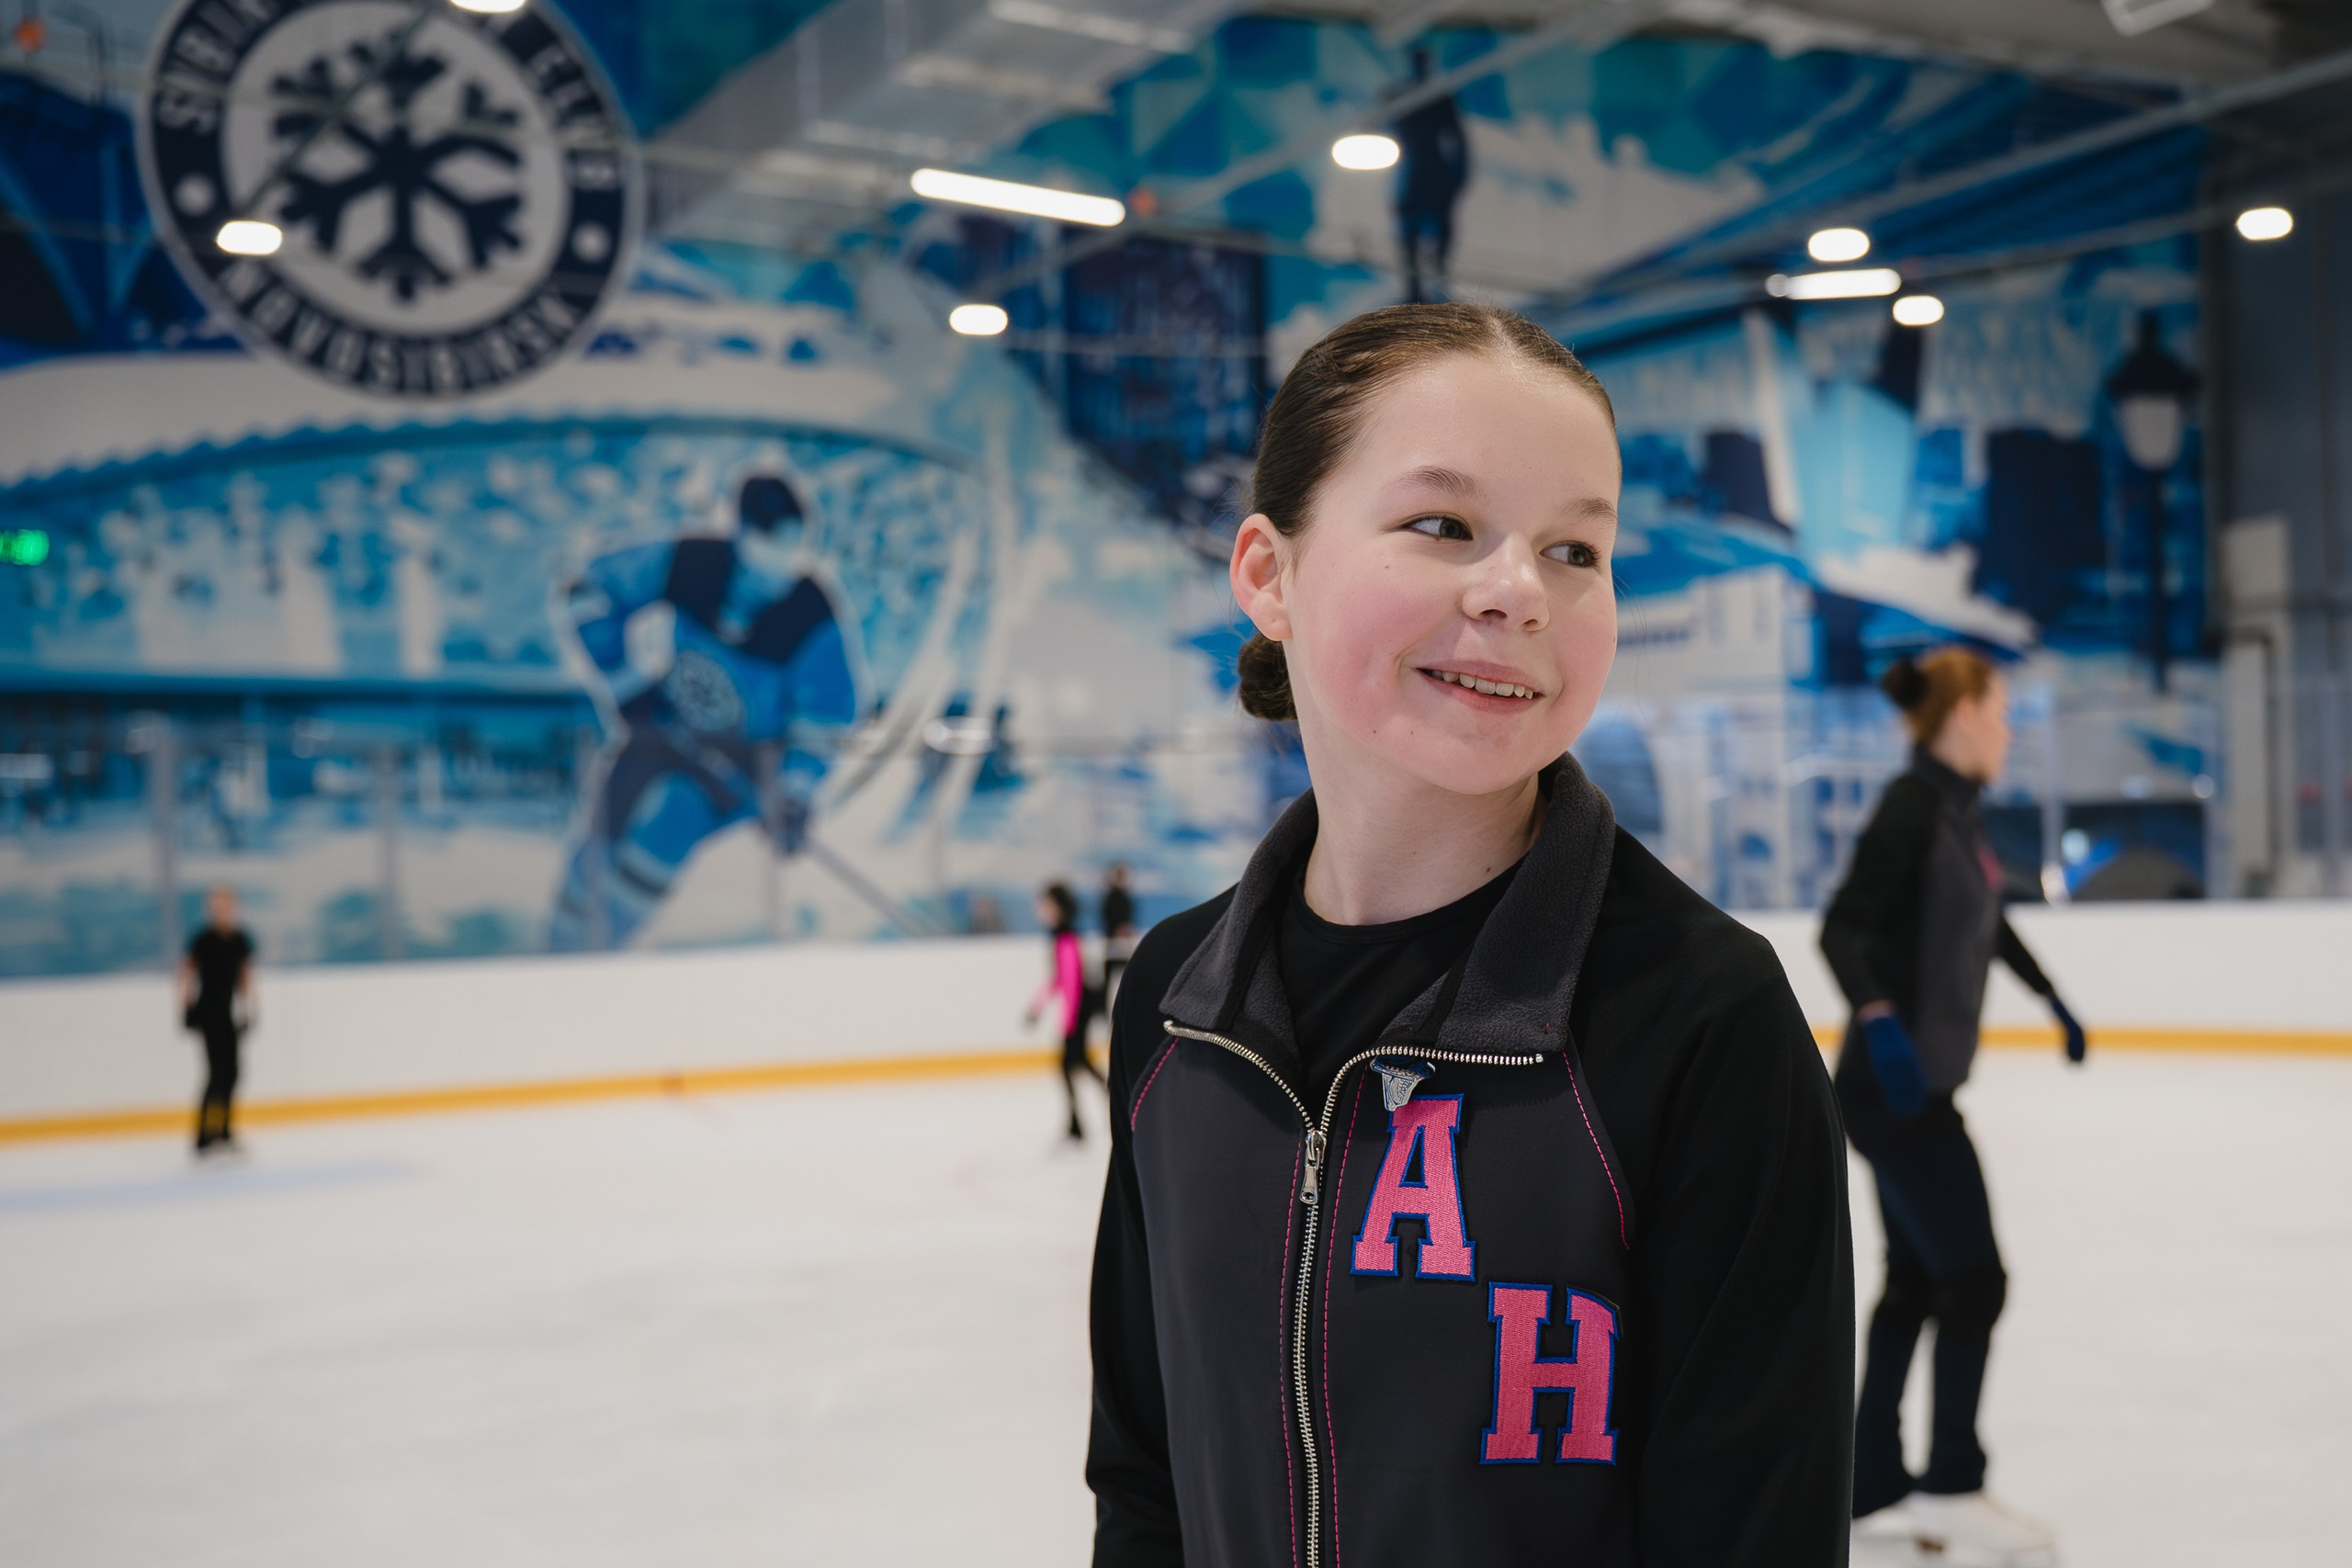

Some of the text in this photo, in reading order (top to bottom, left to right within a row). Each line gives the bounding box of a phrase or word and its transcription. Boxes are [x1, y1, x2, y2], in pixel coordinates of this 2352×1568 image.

[220, 261, 582, 393] NOVOSIBIRSK
[1350, 1092, 1476, 1282] A
[1479, 1281, 1621, 1466] H
